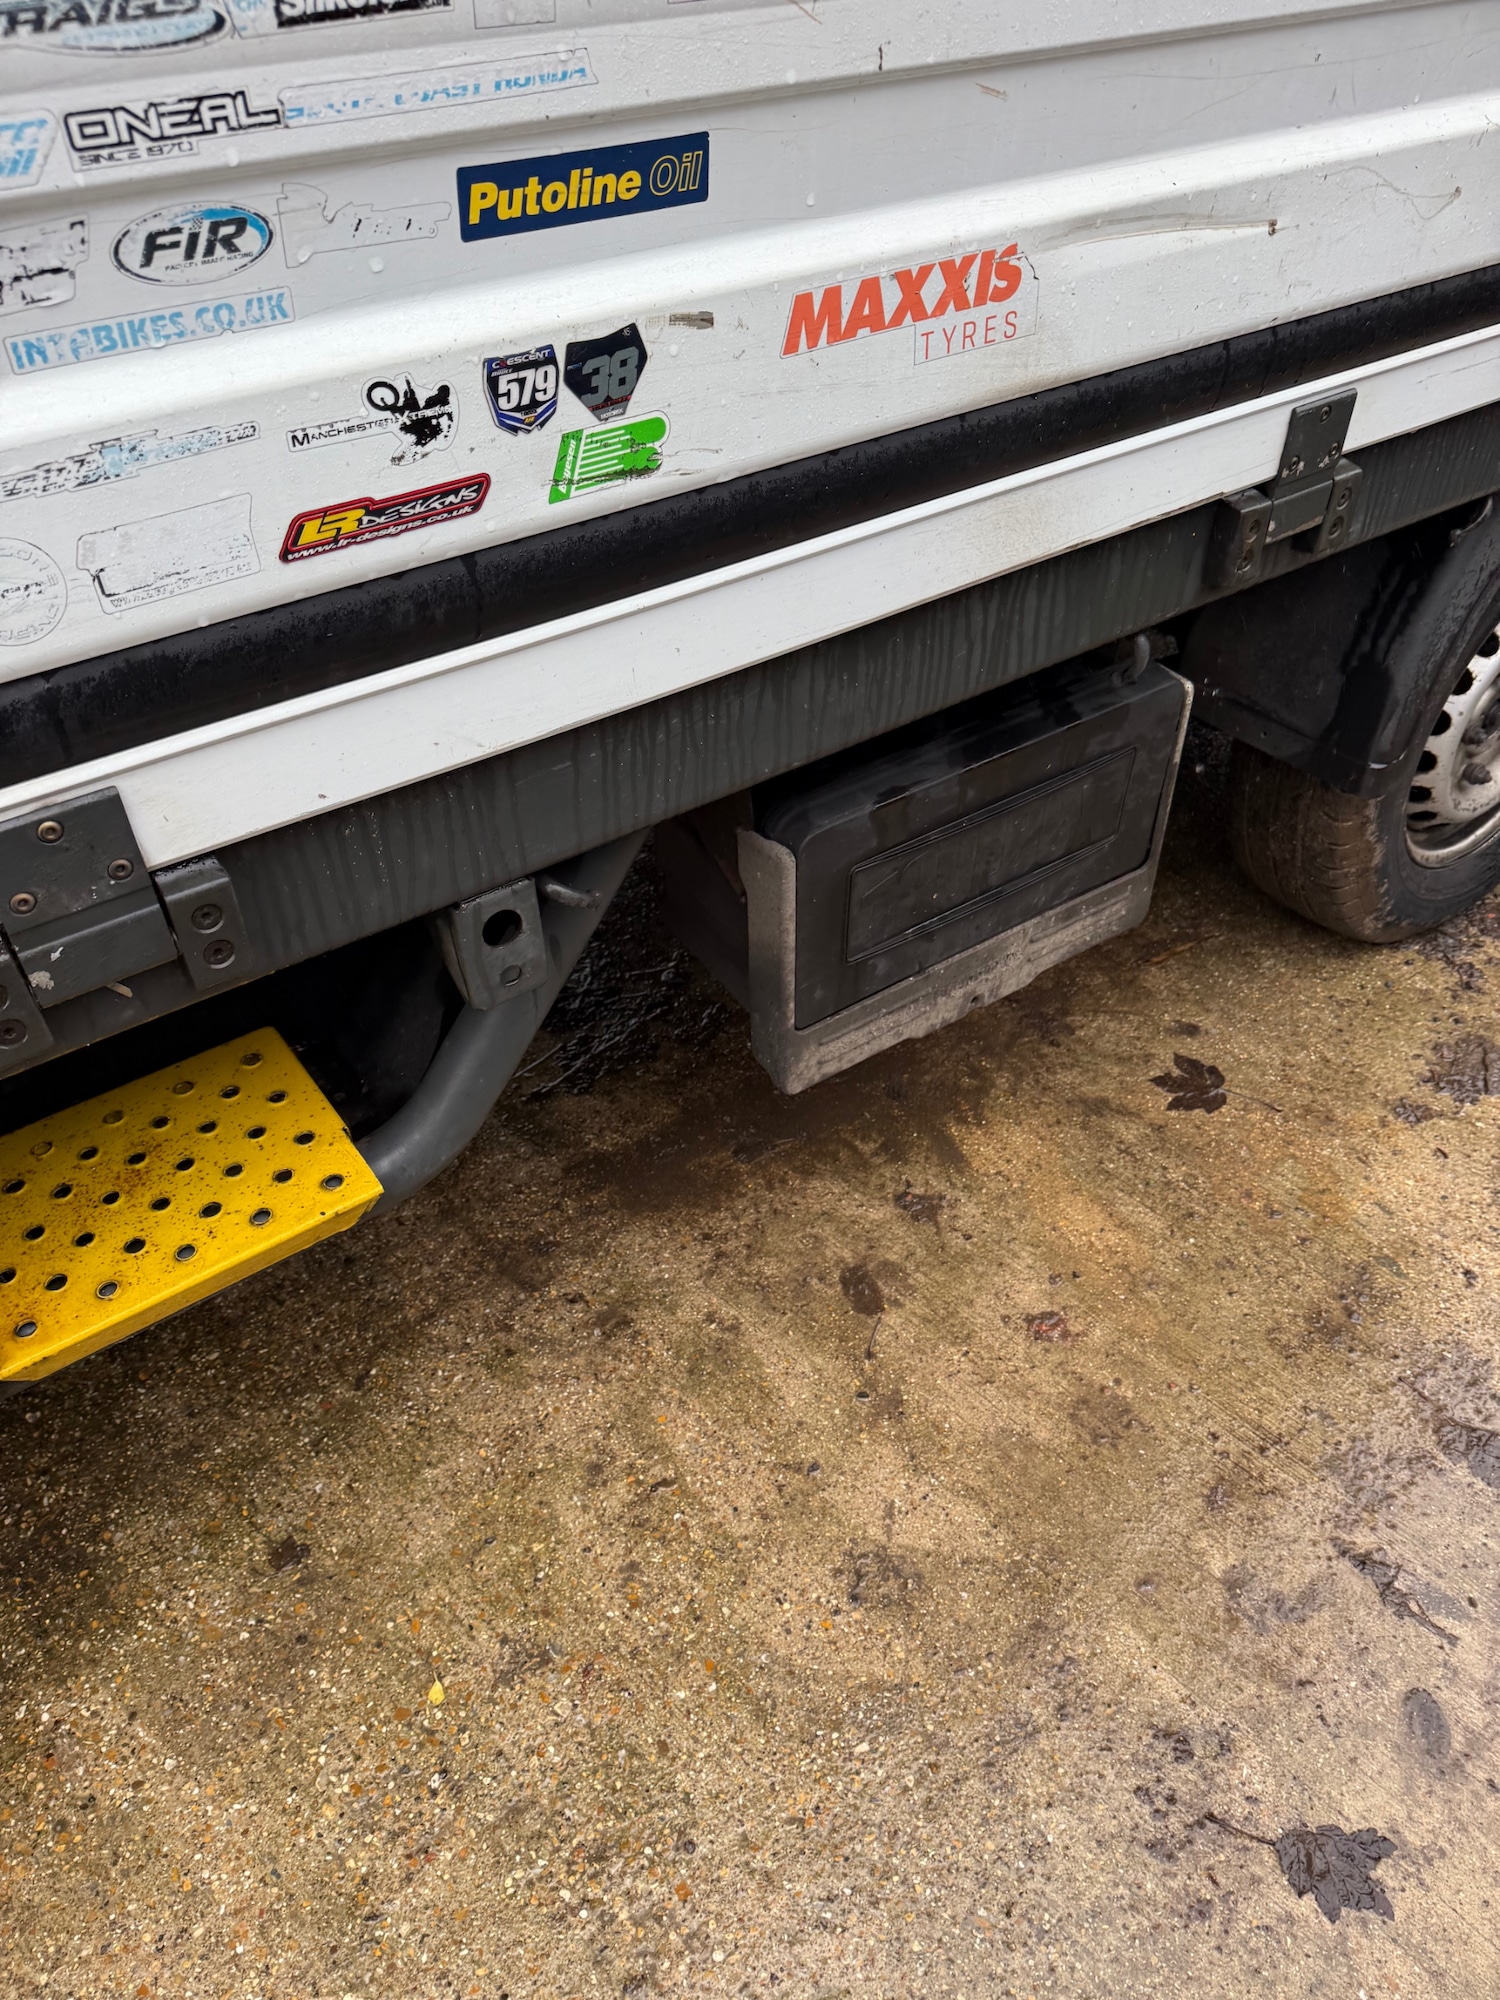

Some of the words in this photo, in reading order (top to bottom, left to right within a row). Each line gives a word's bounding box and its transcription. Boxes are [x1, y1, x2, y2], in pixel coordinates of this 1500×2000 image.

[65, 90, 282, 151] ONEAL
[468, 166, 642, 226] Putoline
[648, 150, 704, 198] Oil
[782, 243, 1023, 356] MAXXIS
[920, 310, 1018, 360] TYRES
[497, 364, 557, 411] 579
[581, 346, 640, 406] 38
[287, 504, 475, 561] www.lr-designs.co.uk
[297, 508, 366, 546] LR
